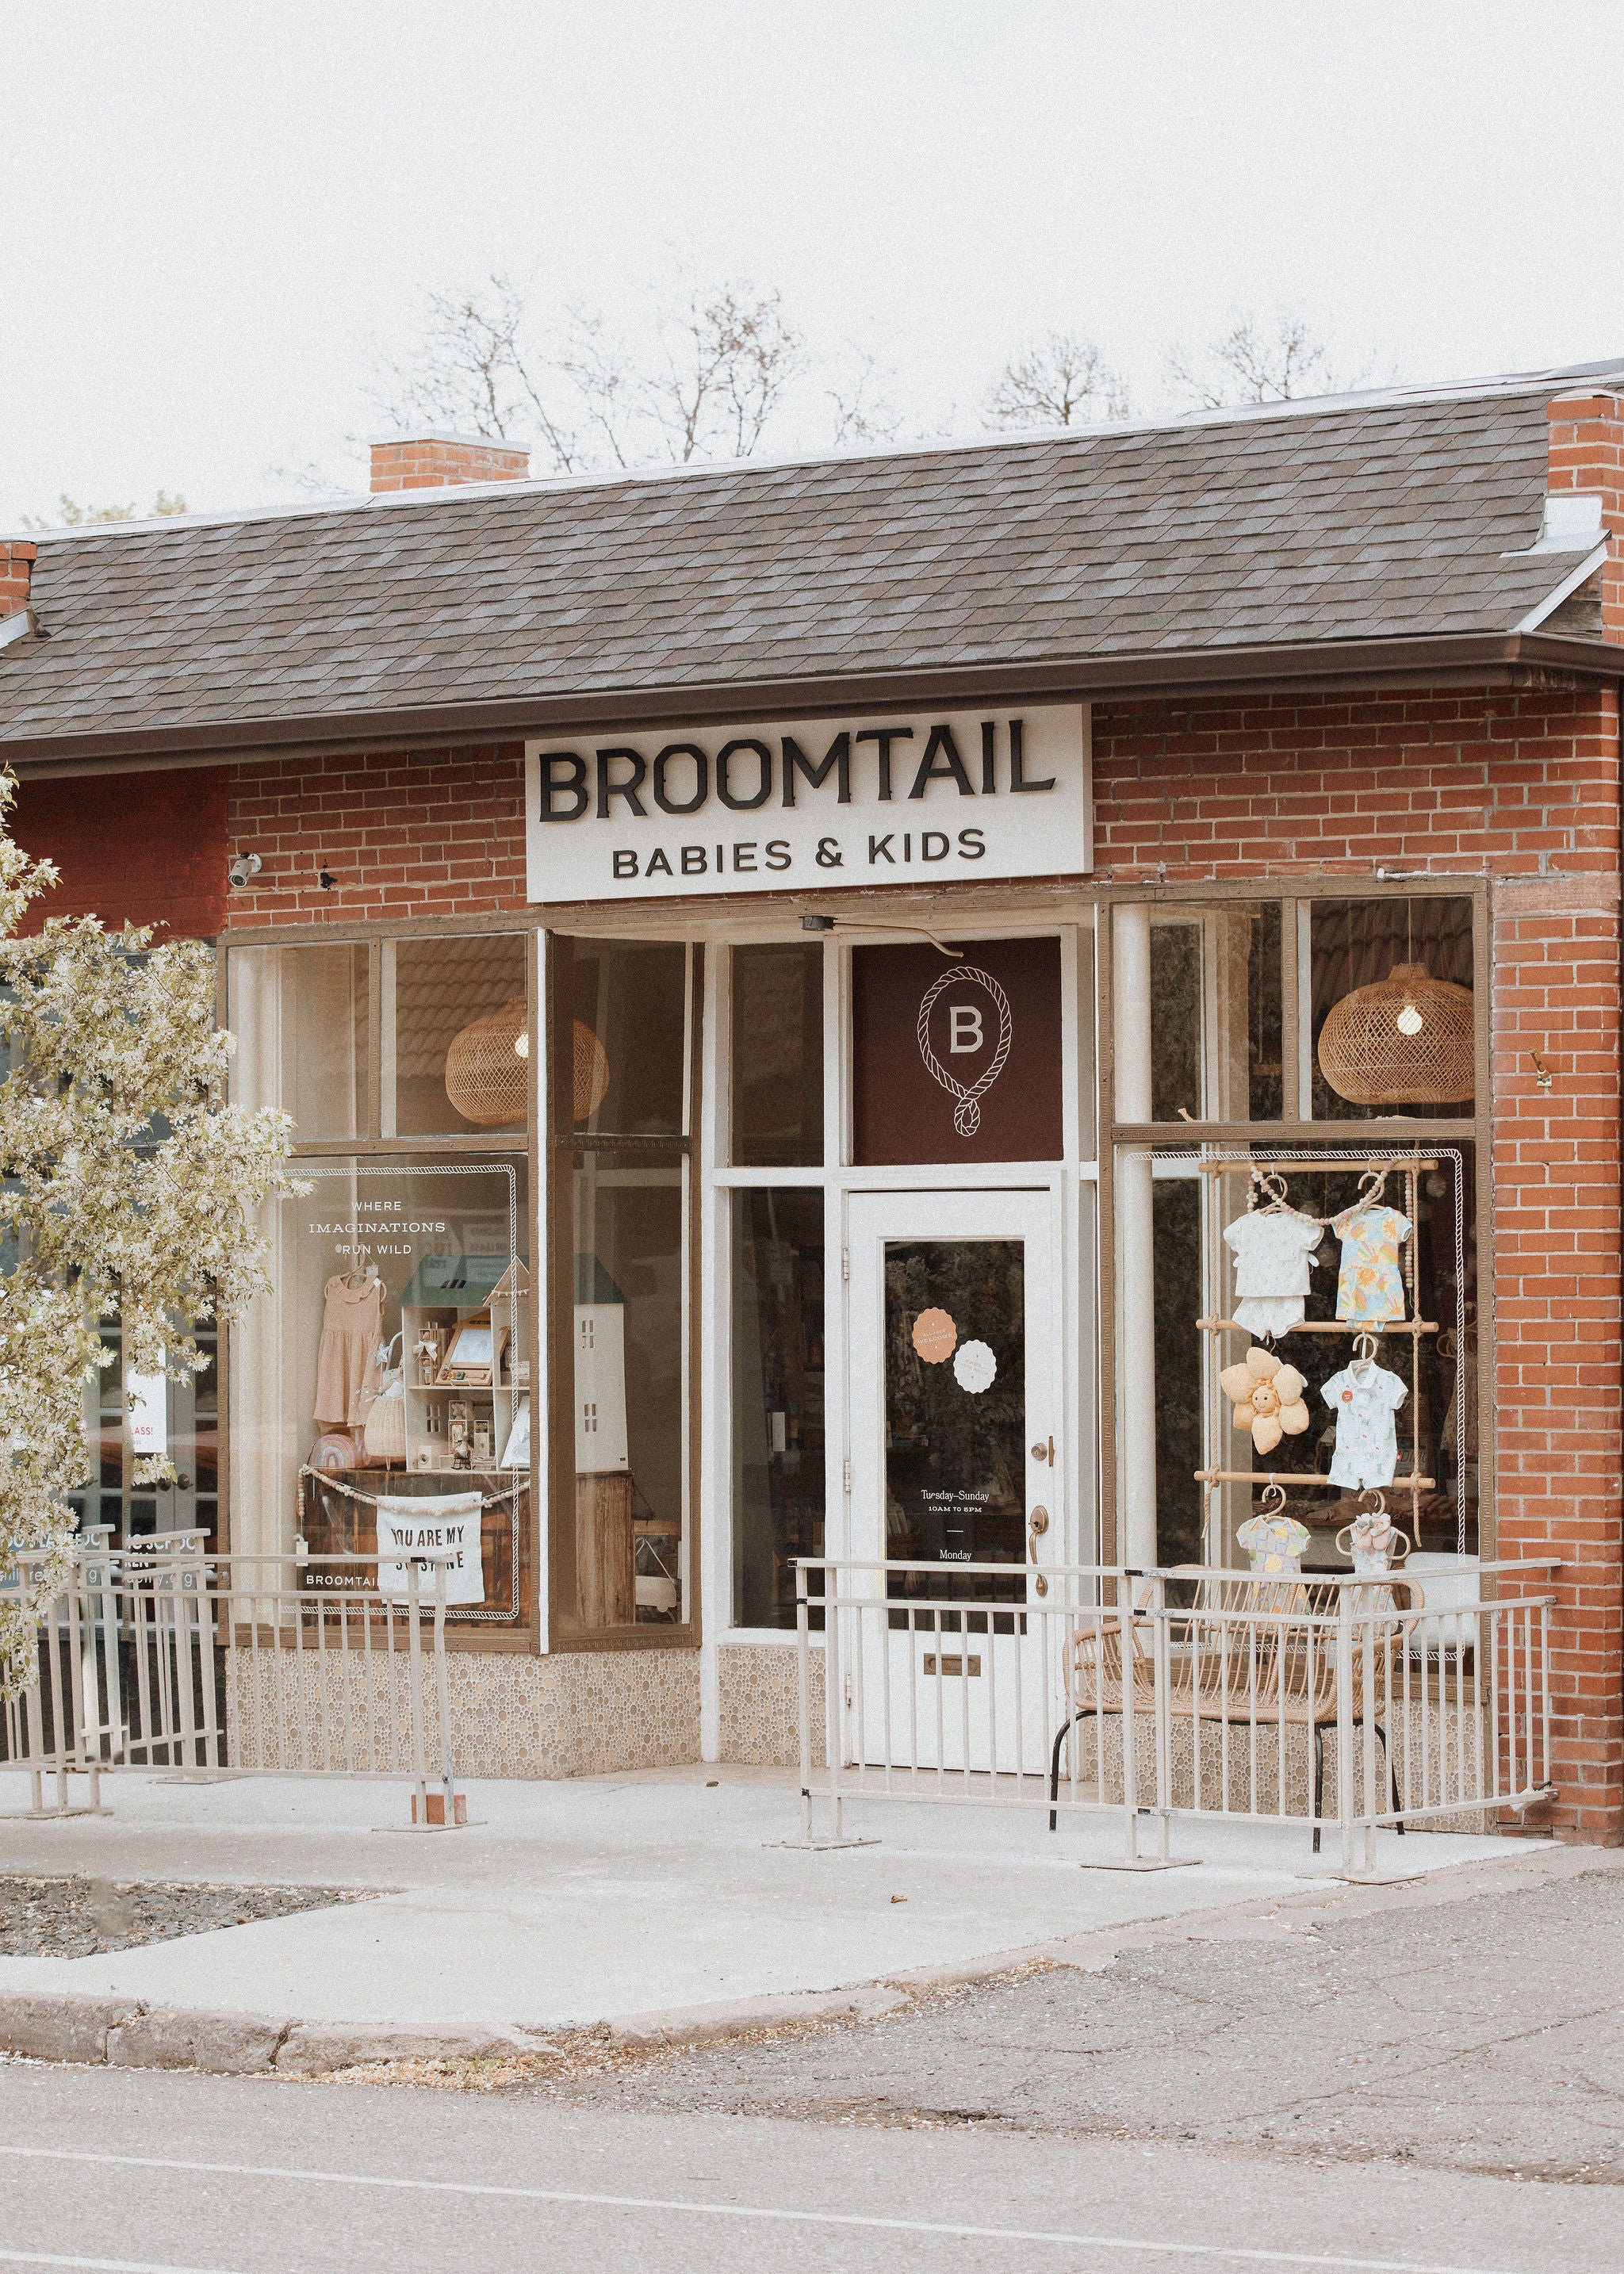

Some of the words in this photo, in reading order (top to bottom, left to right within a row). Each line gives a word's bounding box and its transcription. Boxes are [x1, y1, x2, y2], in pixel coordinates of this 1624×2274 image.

[538, 719, 1056, 822] BROOMTAIL
[613, 840, 792, 879] BABIES
[816, 837, 843, 867] &
[868, 829, 986, 864] KIDS
[950, 1005, 983, 1053] B
[352, 1201, 402, 1211] WHERE
[308, 1222, 446, 1233] IMAGINATIONS
[343, 1245, 371, 1254] RUN
[377, 1245, 412, 1254] WILD
[391, 1528, 413, 1547] YOU
[417, 1529, 442, 1547] ARE
[446, 1526, 465, 1545] MY
[940, 1549, 971, 1561] Monday
